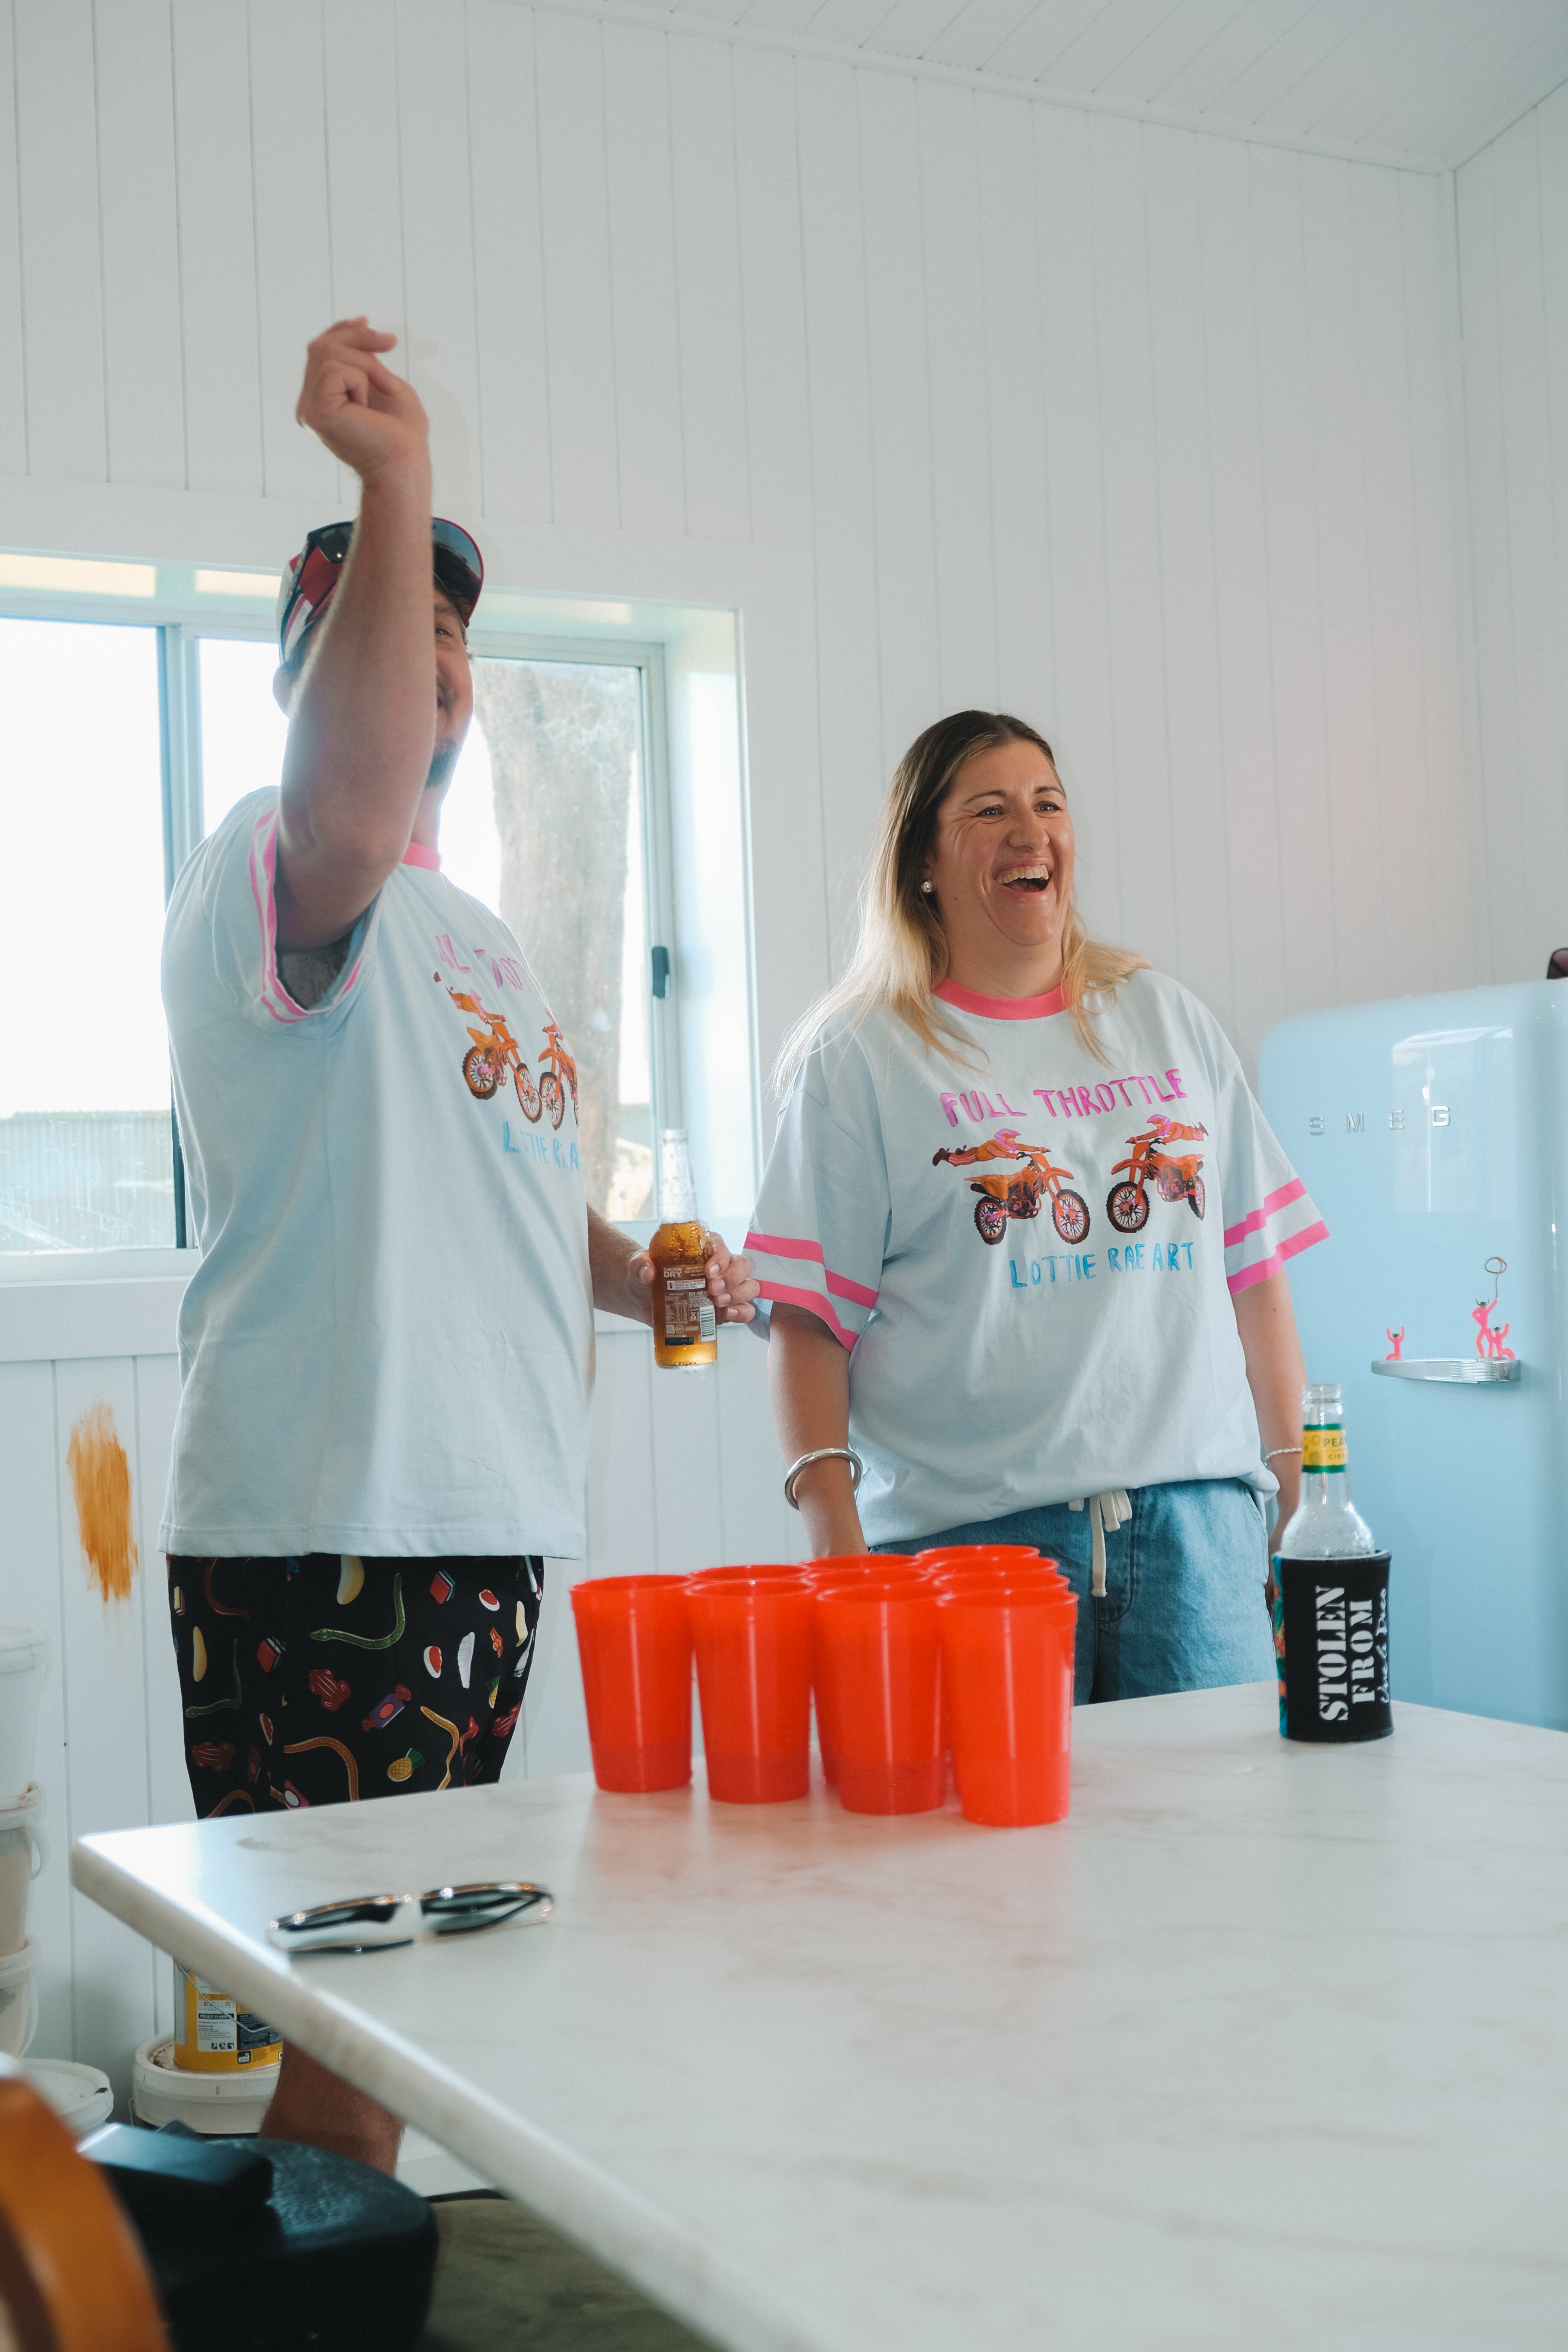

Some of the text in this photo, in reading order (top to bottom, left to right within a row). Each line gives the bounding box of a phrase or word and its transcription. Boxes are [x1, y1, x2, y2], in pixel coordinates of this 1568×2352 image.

[940, 1069, 1188, 1127] FULL THROTTLE
[1309, 1105, 1450, 1136] SMEG
[1009, 1242, 1194, 1288] LOTTIE RAE ART
[1315, 1585, 1348, 1720] STOLEN
[1349, 1600, 1375, 1704] FROM
